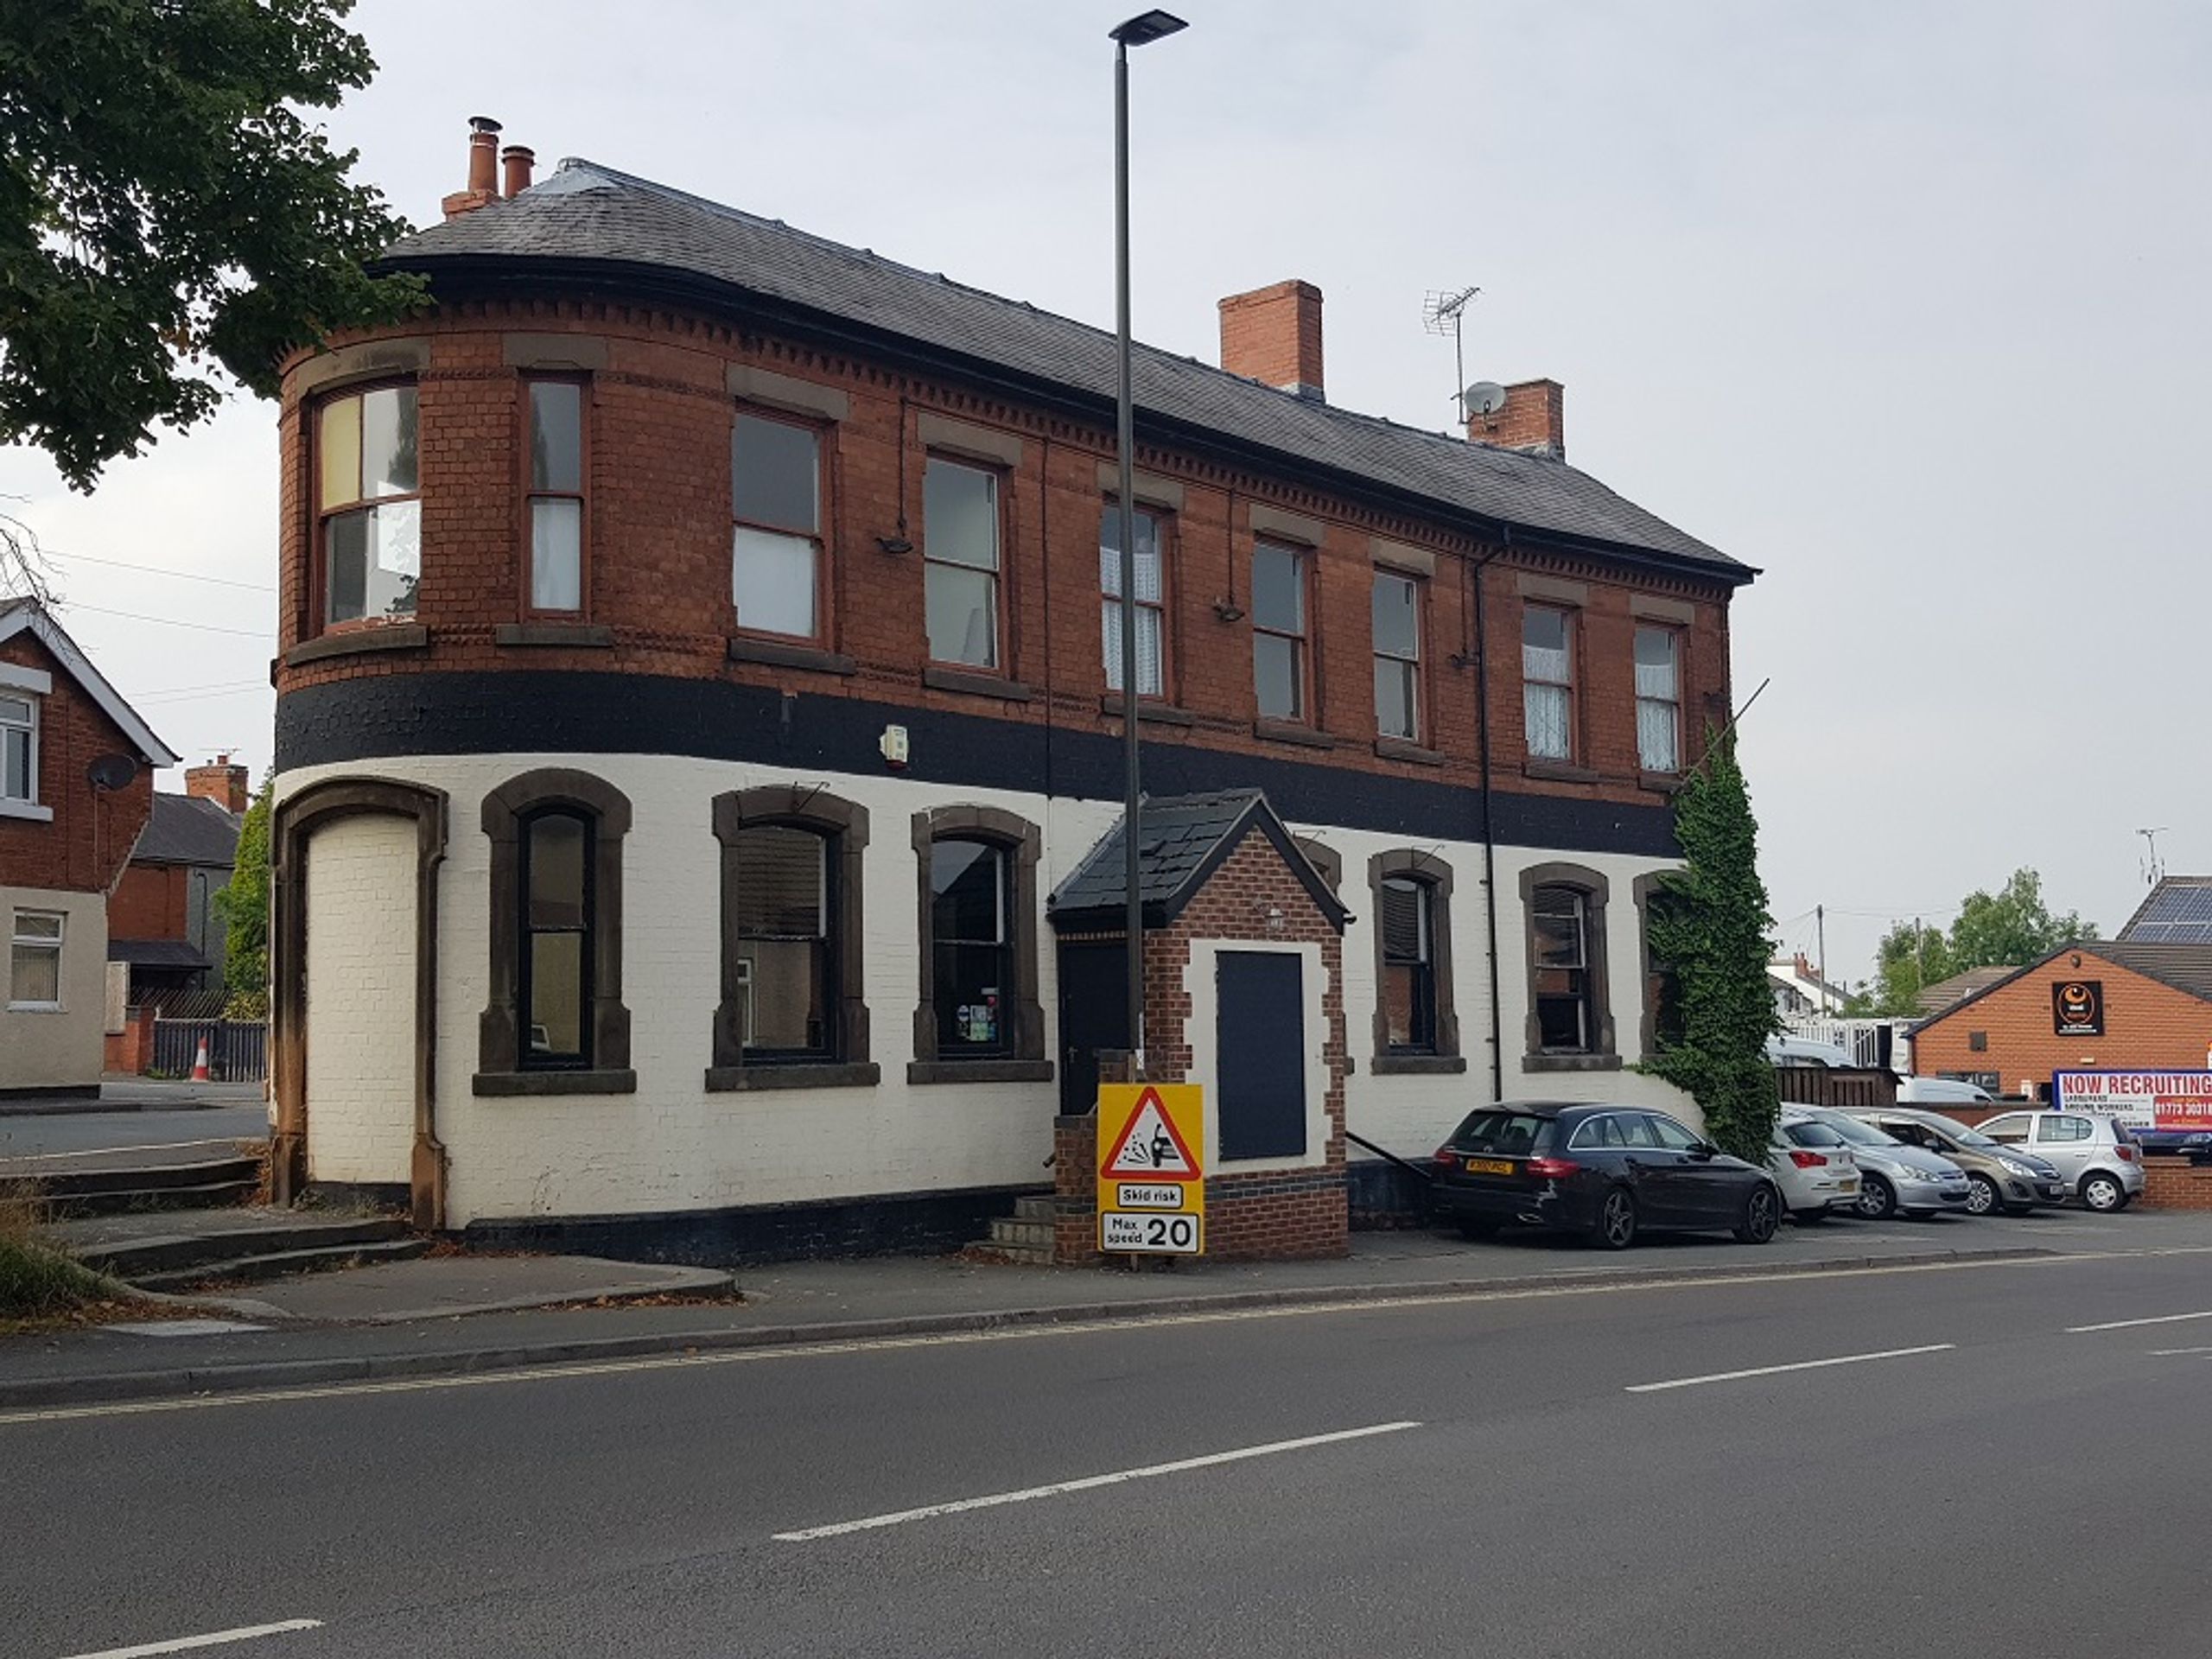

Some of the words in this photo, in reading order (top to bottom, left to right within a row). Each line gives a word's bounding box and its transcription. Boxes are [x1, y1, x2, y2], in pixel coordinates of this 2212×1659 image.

[2063, 1075, 2101, 1094] NOW
[2108, 1075, 2212, 1094] RECRUITING
[1123, 1189, 1151, 1201] Skid
[1154, 1189, 1177, 1201] risk
[1112, 1218, 1138, 1230] Max
[1108, 1232, 1142, 1246] speed
[1147, 1218, 1192, 1247] 20
